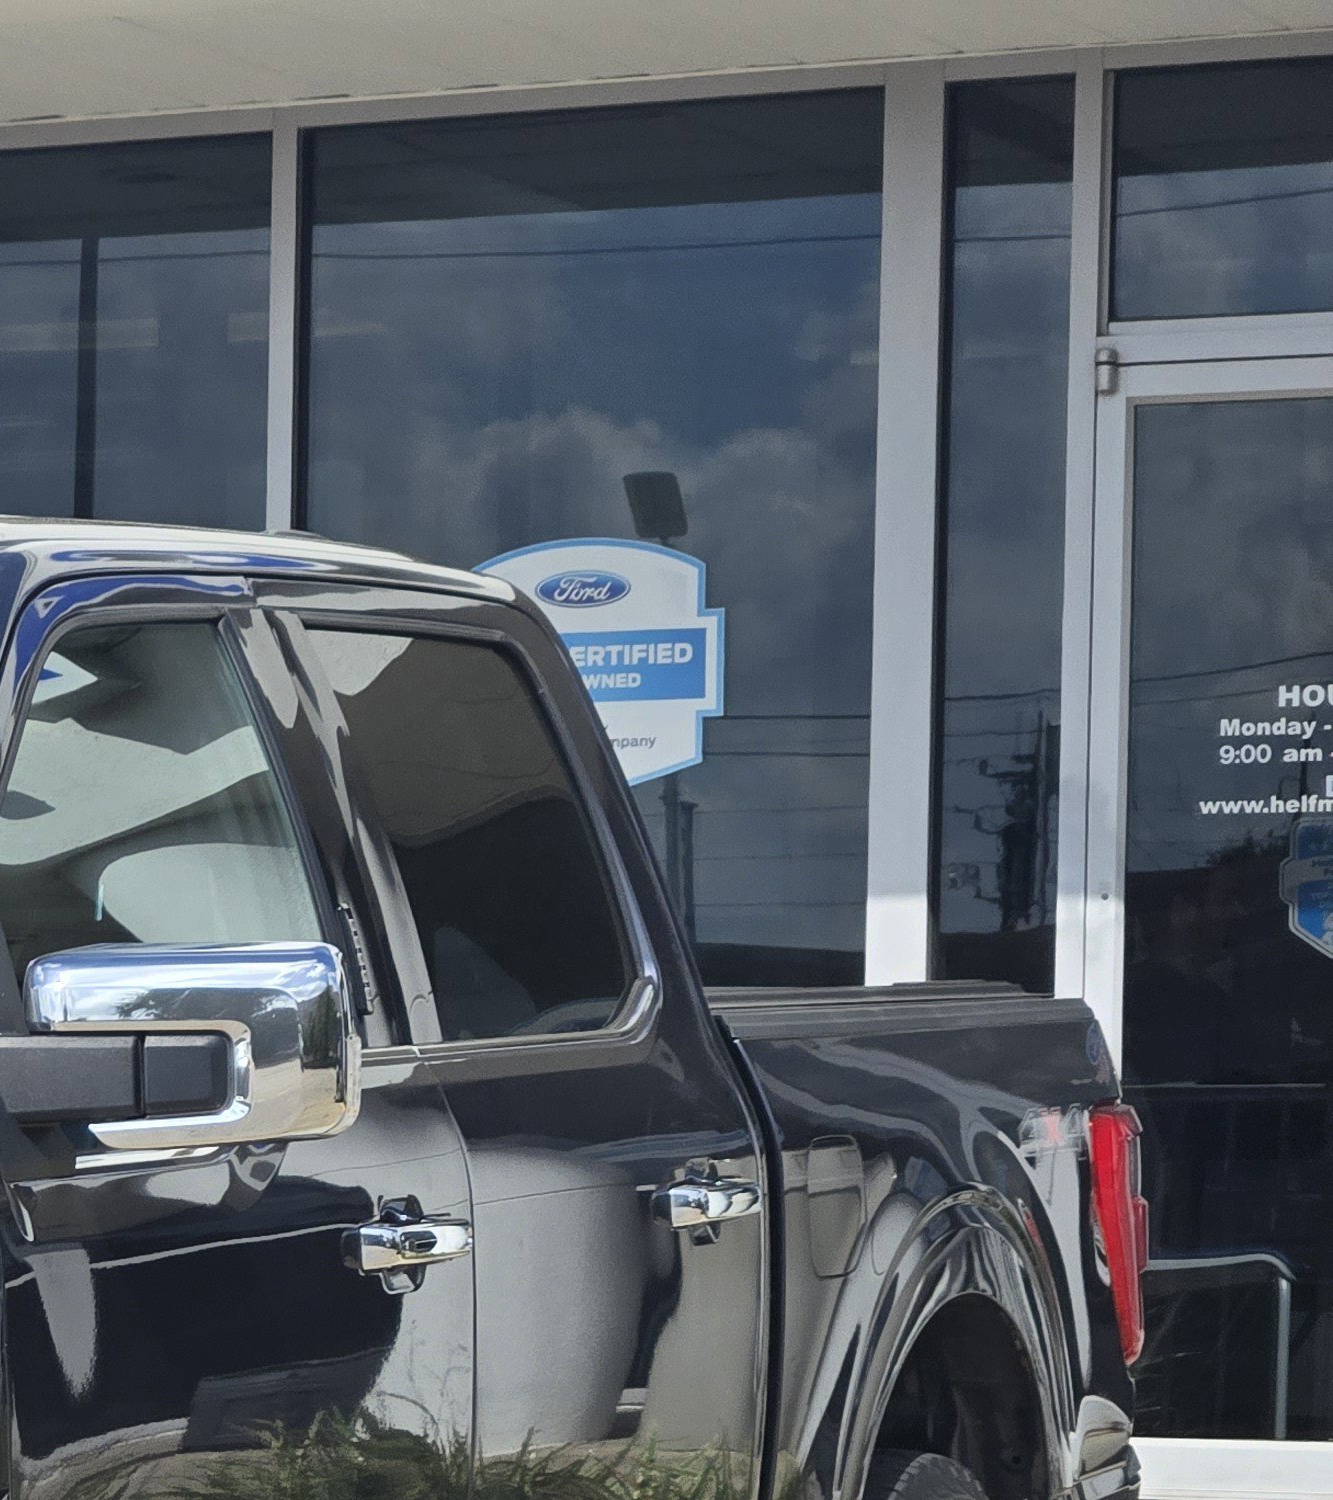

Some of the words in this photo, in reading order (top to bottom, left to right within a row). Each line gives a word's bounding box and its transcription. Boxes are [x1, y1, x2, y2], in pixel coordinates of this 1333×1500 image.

[554, 576, 613, 601] Ford
[570, 642, 693, 667] ERTIFIED
[583, 672, 642, 689] WNED
[1219, 717, 1317, 739] Monday
[1219, 744, 1272, 765] 9:00
[1282, 747, 1323, 762] am
